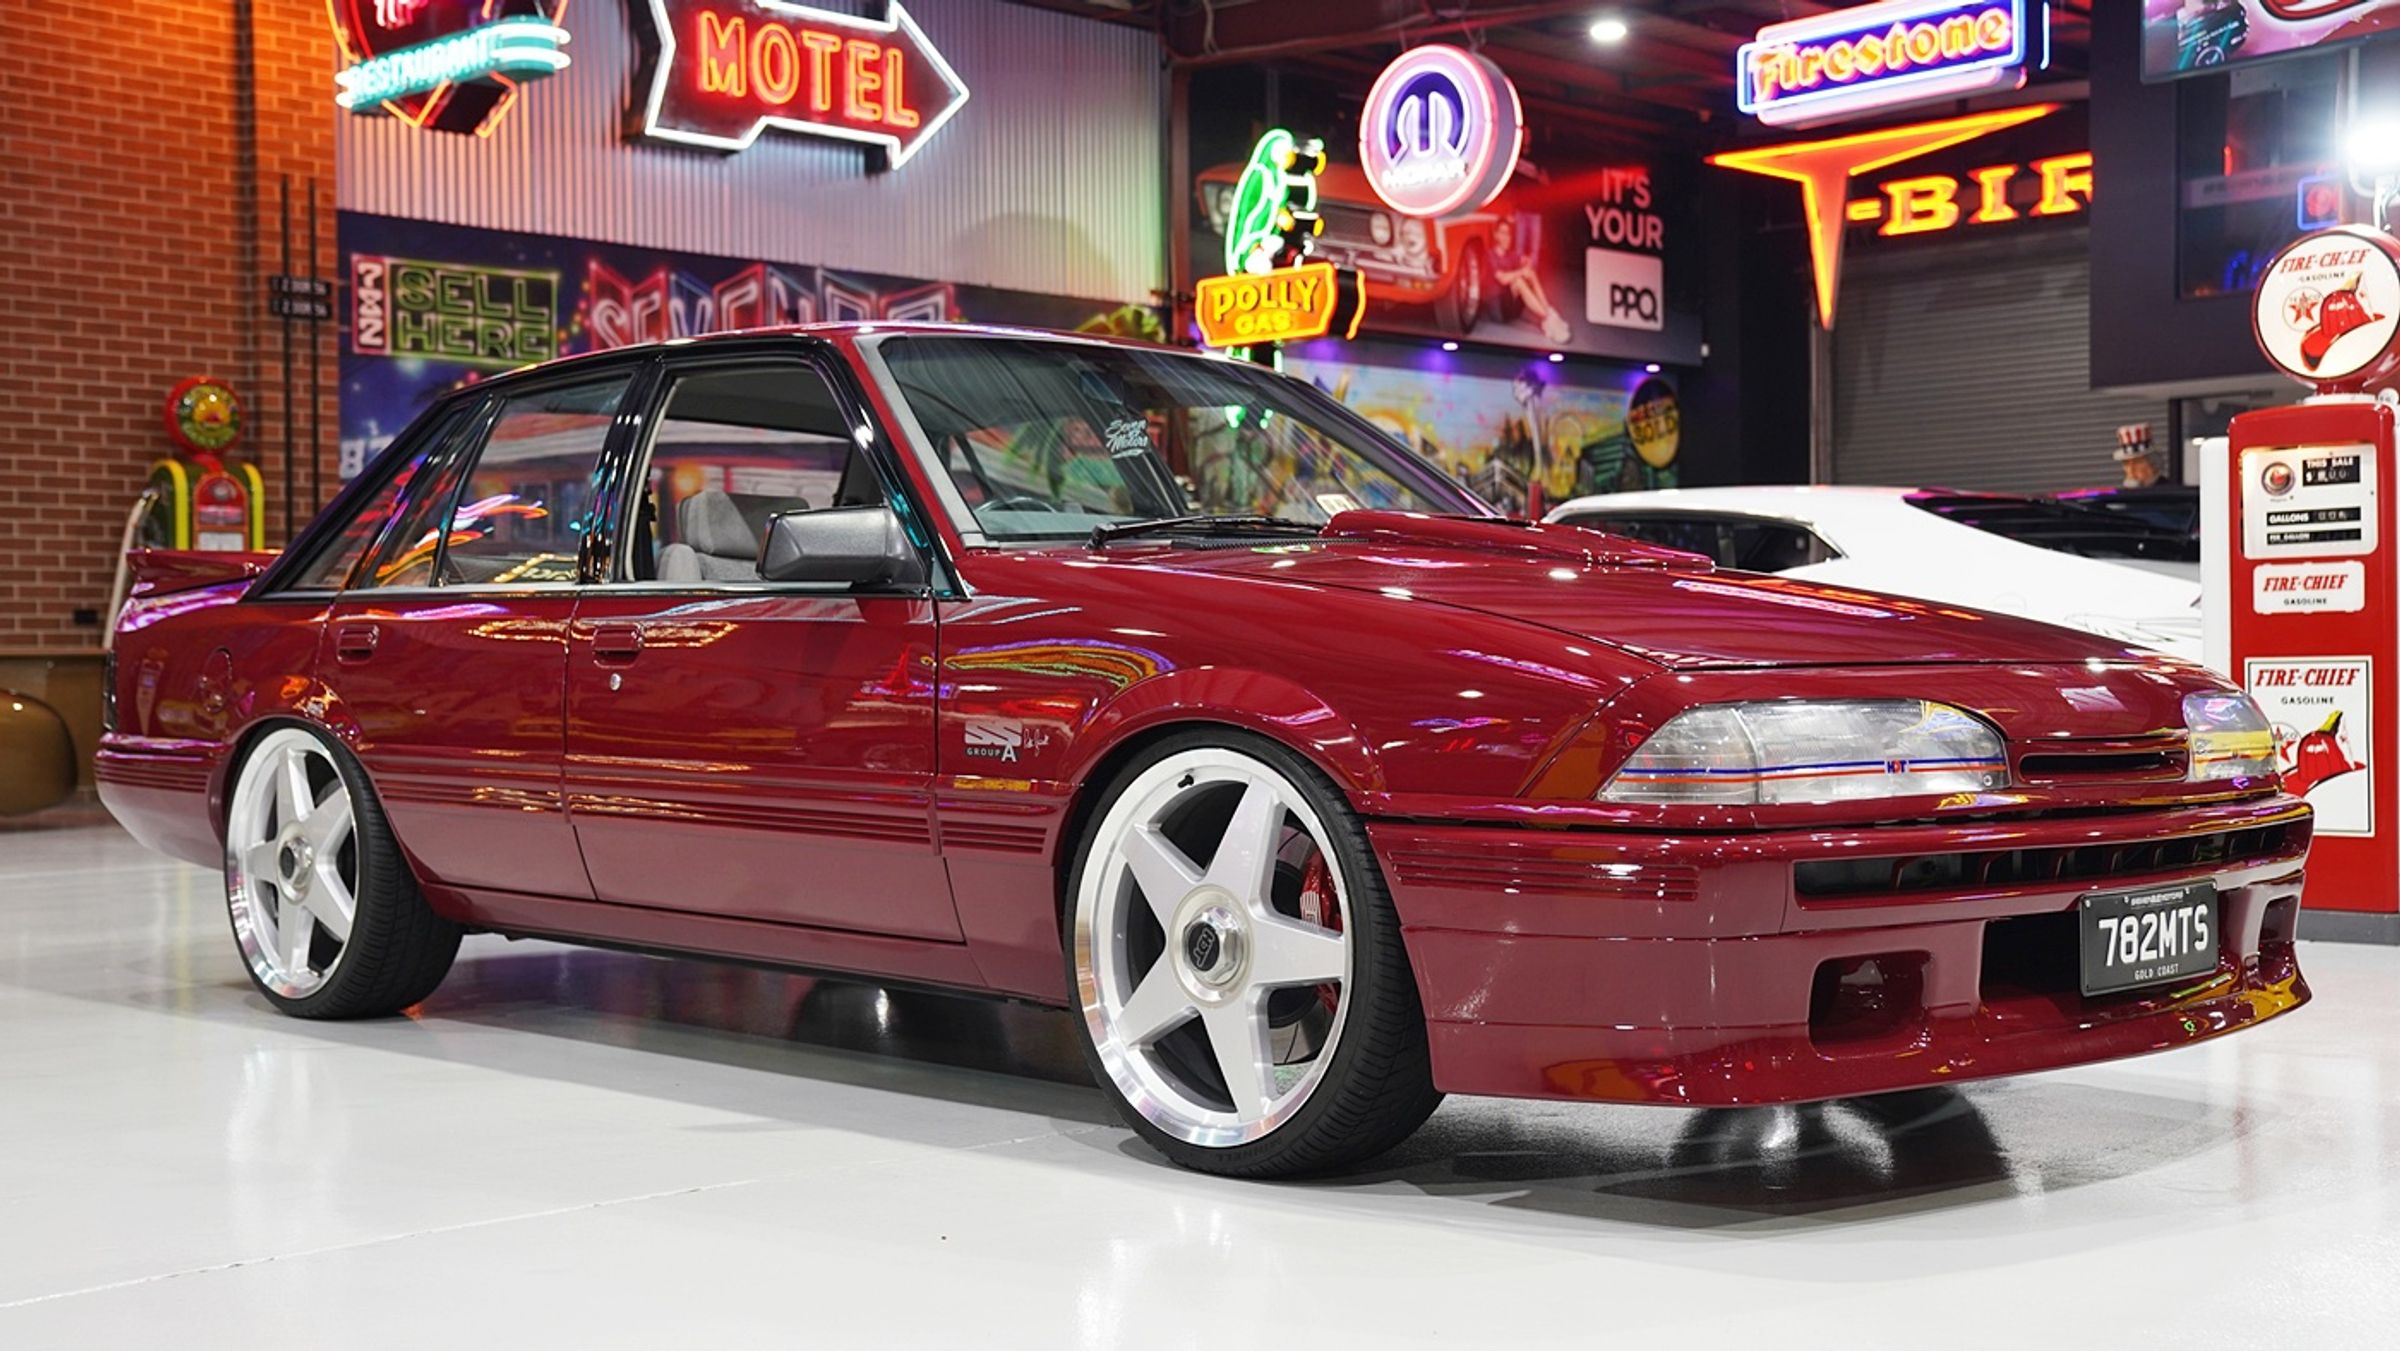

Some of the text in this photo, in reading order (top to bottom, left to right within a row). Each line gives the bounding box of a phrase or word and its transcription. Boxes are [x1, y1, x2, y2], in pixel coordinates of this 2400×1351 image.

[348, 28, 491, 99] RESTAURANT
[698, 10, 920, 128] MOTEL
[1749, 8, 2011, 101] Firestone
[1602, 168, 1650, 208] IT'S
[1585, 204, 1664, 249] YOUR
[396, 267, 549, 321] SELL
[1212, 277, 1318, 322] POLLY
[1610, 283, 1658, 322] PPQ
[396, 310, 549, 361] HERE
[1234, 310, 1291, 335] GAS
[2269, 512, 2309, 524] GALLONS
[2284, 598, 2327, 606] GASOLINE
[2255, 668, 2360, 687] FIRE-CHIEF
[2281, 696, 2334, 705] GASOLINE
[967, 748, 1000, 757] GROUP
[1001, 740, 1018, 762] A
[1193, 928, 1216, 968] HDT
[2098, 904, 2209, 967] 782MTS
[2134, 963, 2180, 981] GOLD COAST
